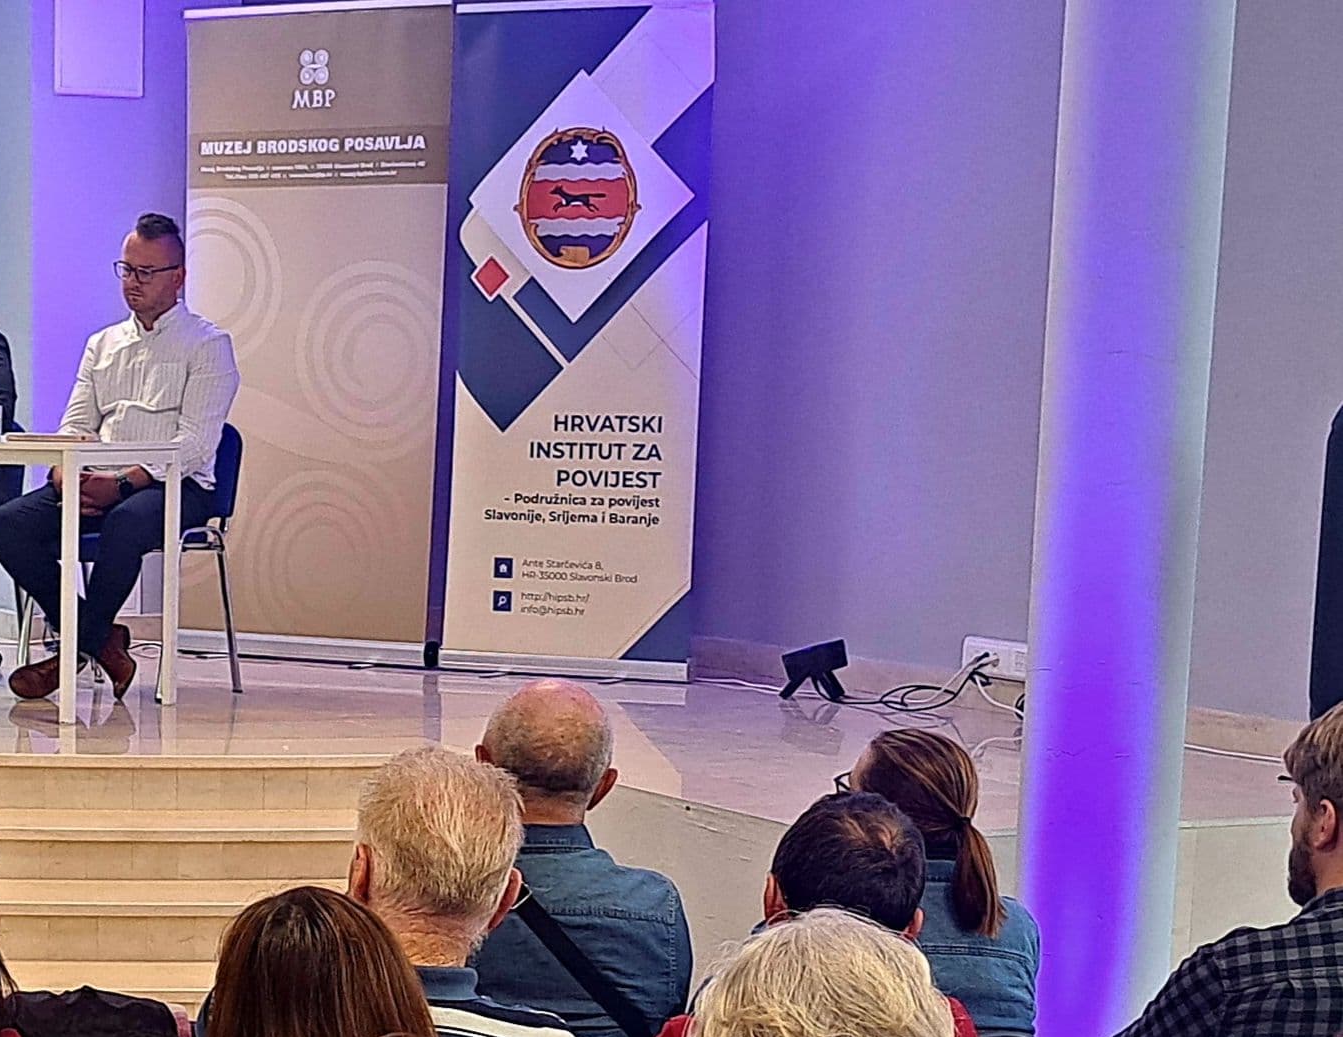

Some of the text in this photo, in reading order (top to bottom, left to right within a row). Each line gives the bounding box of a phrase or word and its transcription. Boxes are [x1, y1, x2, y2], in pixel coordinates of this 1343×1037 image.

[292, 88, 336, 109] MBP
[200, 135, 426, 156] MUZEJ BRODSKOG POSAVLJA
[554, 414, 663, 433] HRVATSKI
[529, 441, 662, 461] INSTITUT ZA
[556, 469, 662, 489] POVIJEST
[514, 493, 587, 506] Podružnica
[590, 497, 604, 506] za
[608, 495, 660, 510] povijest
[484, 509, 660, 528] Slavonije, Srijema i Baranje
[522, 558, 544, 569] Ante
[545, 558, 593, 570] Starčevića
[569, 573, 613, 583] Slavonski
[615, 574, 639, 584] Brod
[520, 604, 586, 616] info@hipsb.hr
